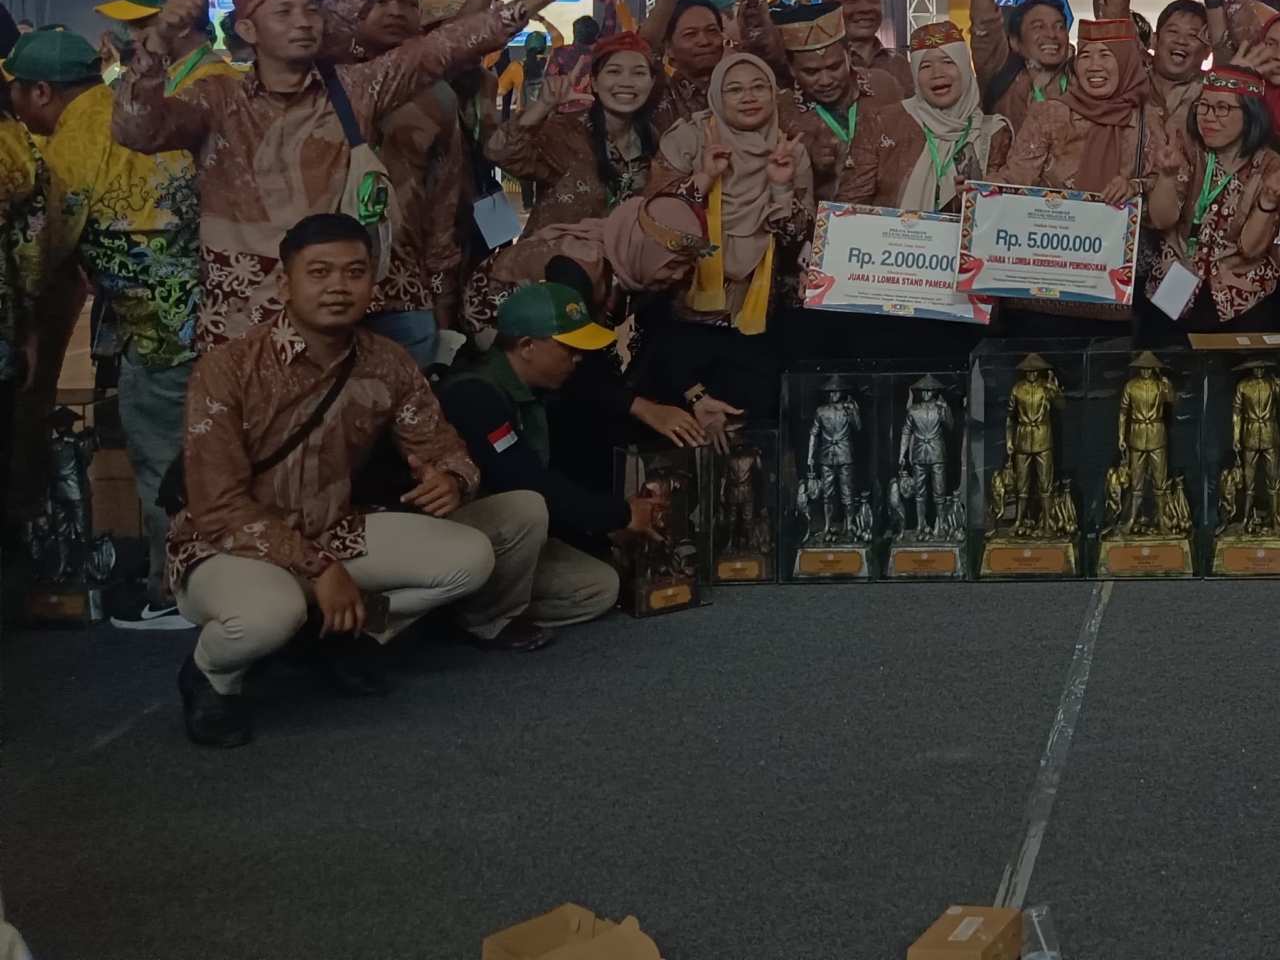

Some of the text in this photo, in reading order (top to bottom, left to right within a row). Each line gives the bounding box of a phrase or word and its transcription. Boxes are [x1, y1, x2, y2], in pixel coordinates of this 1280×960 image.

[996, 229, 1102, 253] Rp. 5.000.000
[848, 247, 875, 269] Rp.
[987, 255, 1006, 263] JUARA
[1012, 256, 1031, 265] LOMBA
[1032, 258, 1068, 269] KEBERSIHAN
[1069, 261, 1107, 272] PEMONDOKAN
[847, 273, 870, 281] JUARA
[877, 276, 900, 285] LOMBA
[902, 278, 923, 287] STAND
